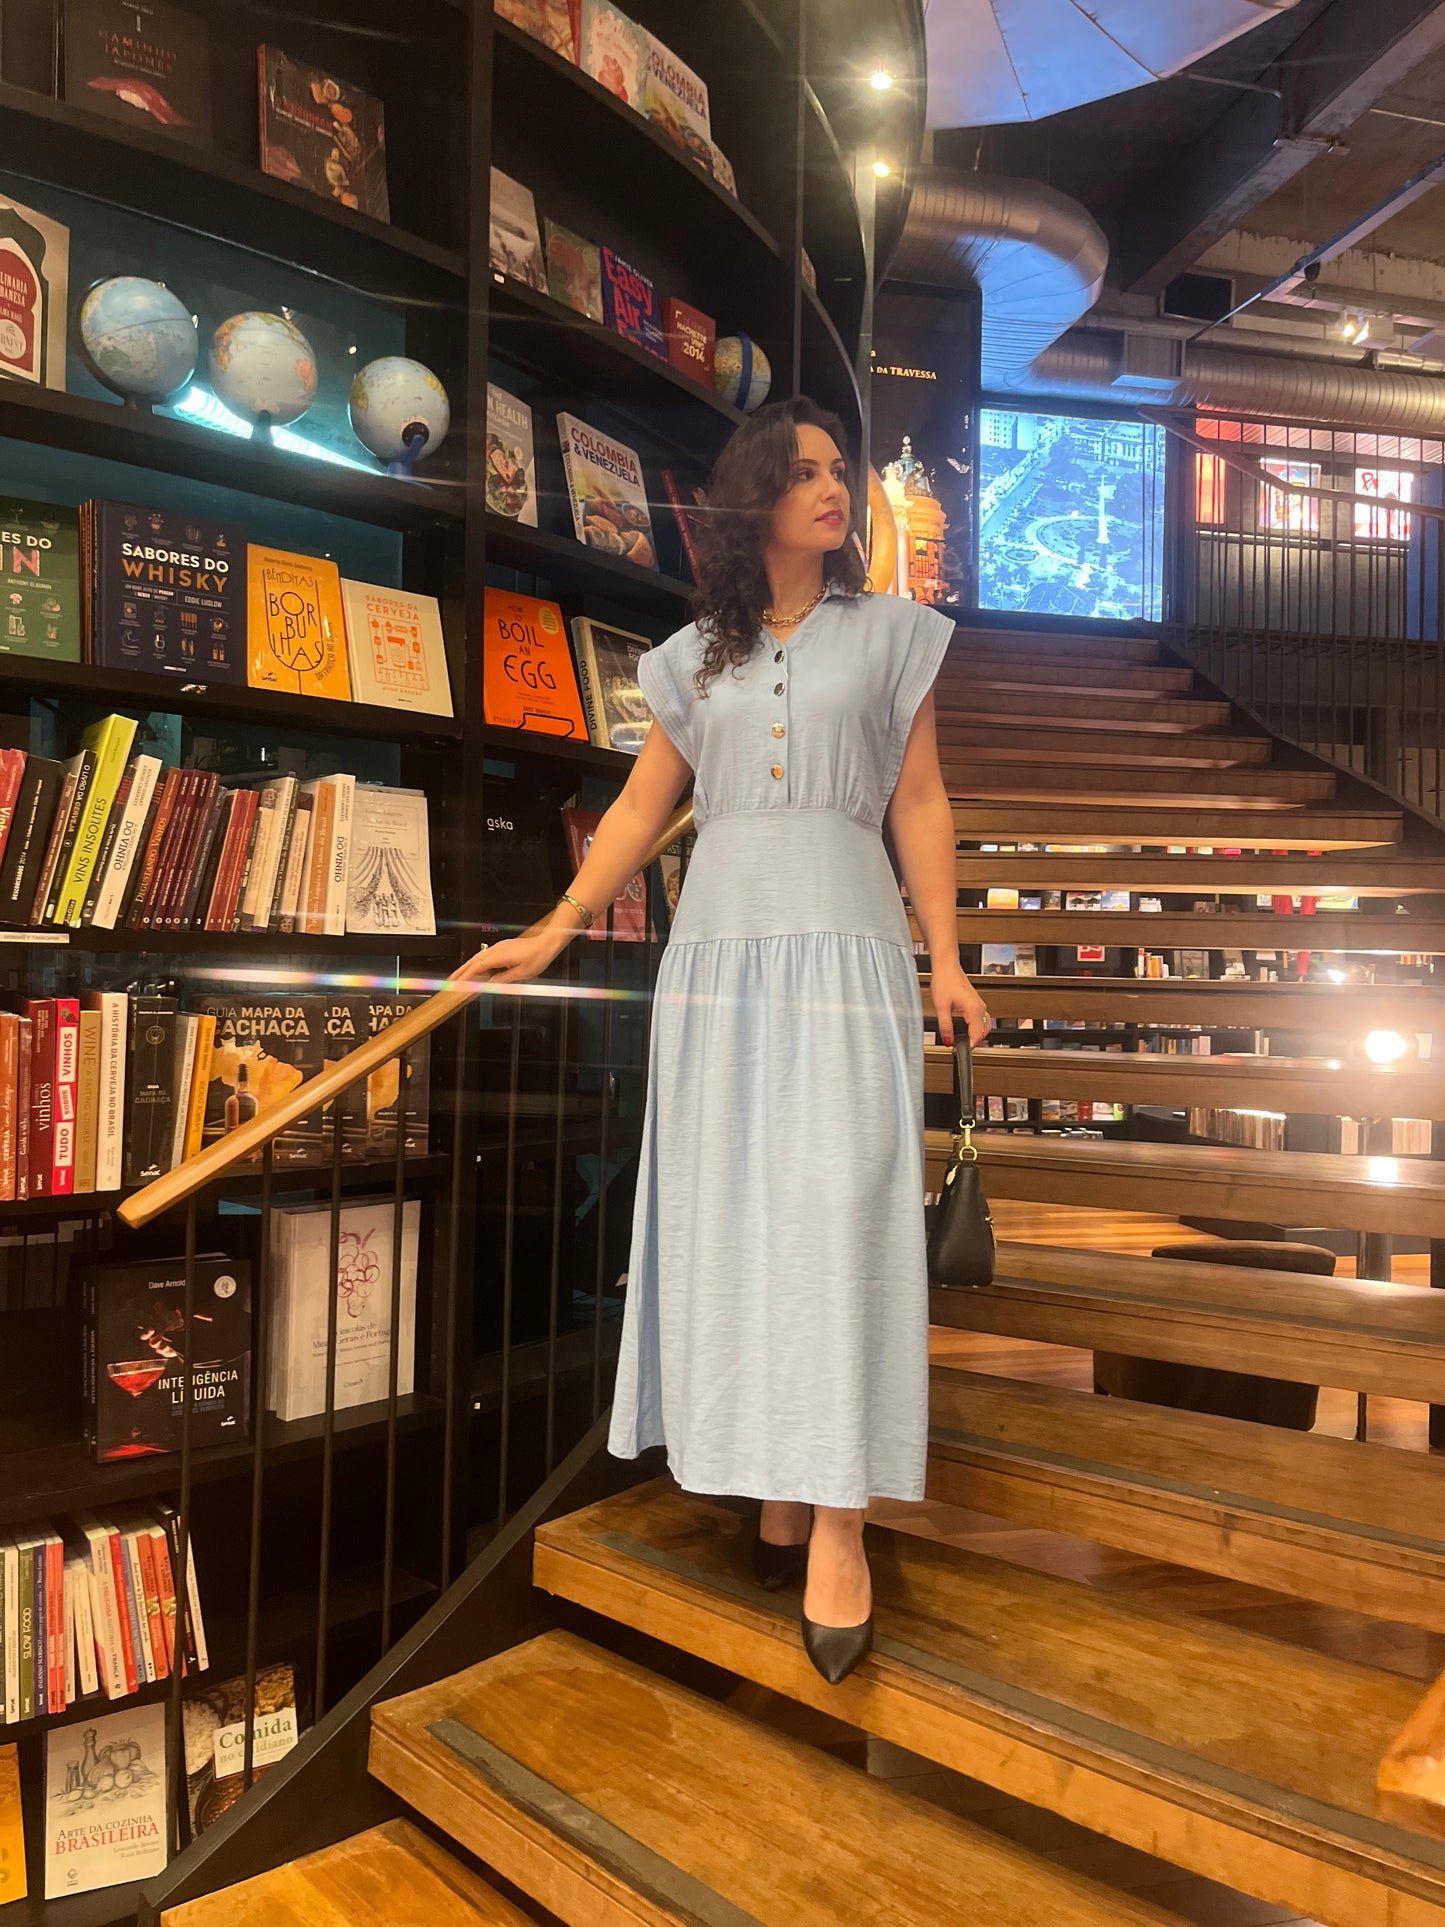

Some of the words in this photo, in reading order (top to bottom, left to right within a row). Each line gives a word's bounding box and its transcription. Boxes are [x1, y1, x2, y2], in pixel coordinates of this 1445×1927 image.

[602, 245, 653, 316] Easy
[613, 283, 641, 331] Air
[677, 322, 707, 344] HACHETTE
[683, 341, 705, 363] 2014
[877, 366, 888, 374] DA
[890, 366, 937, 380] TRAVESSA
[570, 426, 638, 474] COLOMBIA
[574, 443, 583, 456] &
[583, 447, 640, 487] VENEZUELA
[26, 535, 52, 549] DO
[122, 542, 200, 568] SABORES
[205, 558, 229, 573] DO
[121, 558, 228, 593] WHISKY
[266, 568, 314, 588] BENDITAS
[366, 594, 403, 608] SABORES
[407, 603, 419, 611] DA
[367, 603, 420, 621] CERVEJA
[507, 603, 524, 614] HOW
[498, 618, 545, 648] BOIL
[518, 645, 531, 657] AN
[503, 654, 557, 690] EGG
[580, 660, 592, 693] FOOD
[585, 697, 598, 731] DIVINE
[77, 770, 89, 791] LIVRO
[75, 790, 84, 801] DA
[66, 800, 81, 833] CERVEJA
[81, 796, 107, 853] INSOLITES
[122, 819, 134, 837] DO
[487, 817, 514, 831] aska
[112, 836, 129, 871] VINHO
[336, 835, 344, 850] DO
[19, 850, 27, 864] 2014
[73, 855, 90, 884] VINS
[133, 848, 160, 903] DEGUSTANDO
[150, 815, 168, 847] VINHOS
[333, 852, 343, 882] VINHO
[206, 1007, 237, 1018] GUIA
[241, 1007, 282, 1018] MAPA
[285, 1007, 305, 1018] DA
[332, 1007, 351, 1018] DA
[110, 1009, 120, 1046] HISTÓRIA
[61, 1032, 73, 1075] VINHOS
[83, 1025, 97, 1065] WINE
[109, 1048, 117, 1059] DA
[108, 1060, 117, 1095] CERVEJA
[30, 1081, 51, 1131] vinhos
[60, 1089, 71, 1114] SOBRE
[108, 1096, 115, 1107] NO
[106, 1109, 115, 1138] BRASIL
[58, 1128, 69, 1160] TUDO
[148, 1281, 164, 1290] Dave
[165, 1279, 186, 1288] Arnold
[158, 1369, 239, 1390] INTEIGÊNCIA
[171, 1386, 226, 1404] LÍUIDA
[22, 1607, 31, 1632] FOOD
[102, 1585, 112, 1617] DELICIOSA
[110, 1653, 119, 1678] FRANÇA
[22, 1634, 31, 1659] SLOW
[55, 1822, 160, 1855] BRASILEIRA
[57, 1828, 86, 1840] ARTE
[89, 1823, 104, 1834] DA
[106, 1814, 153, 1831] COZINHA
